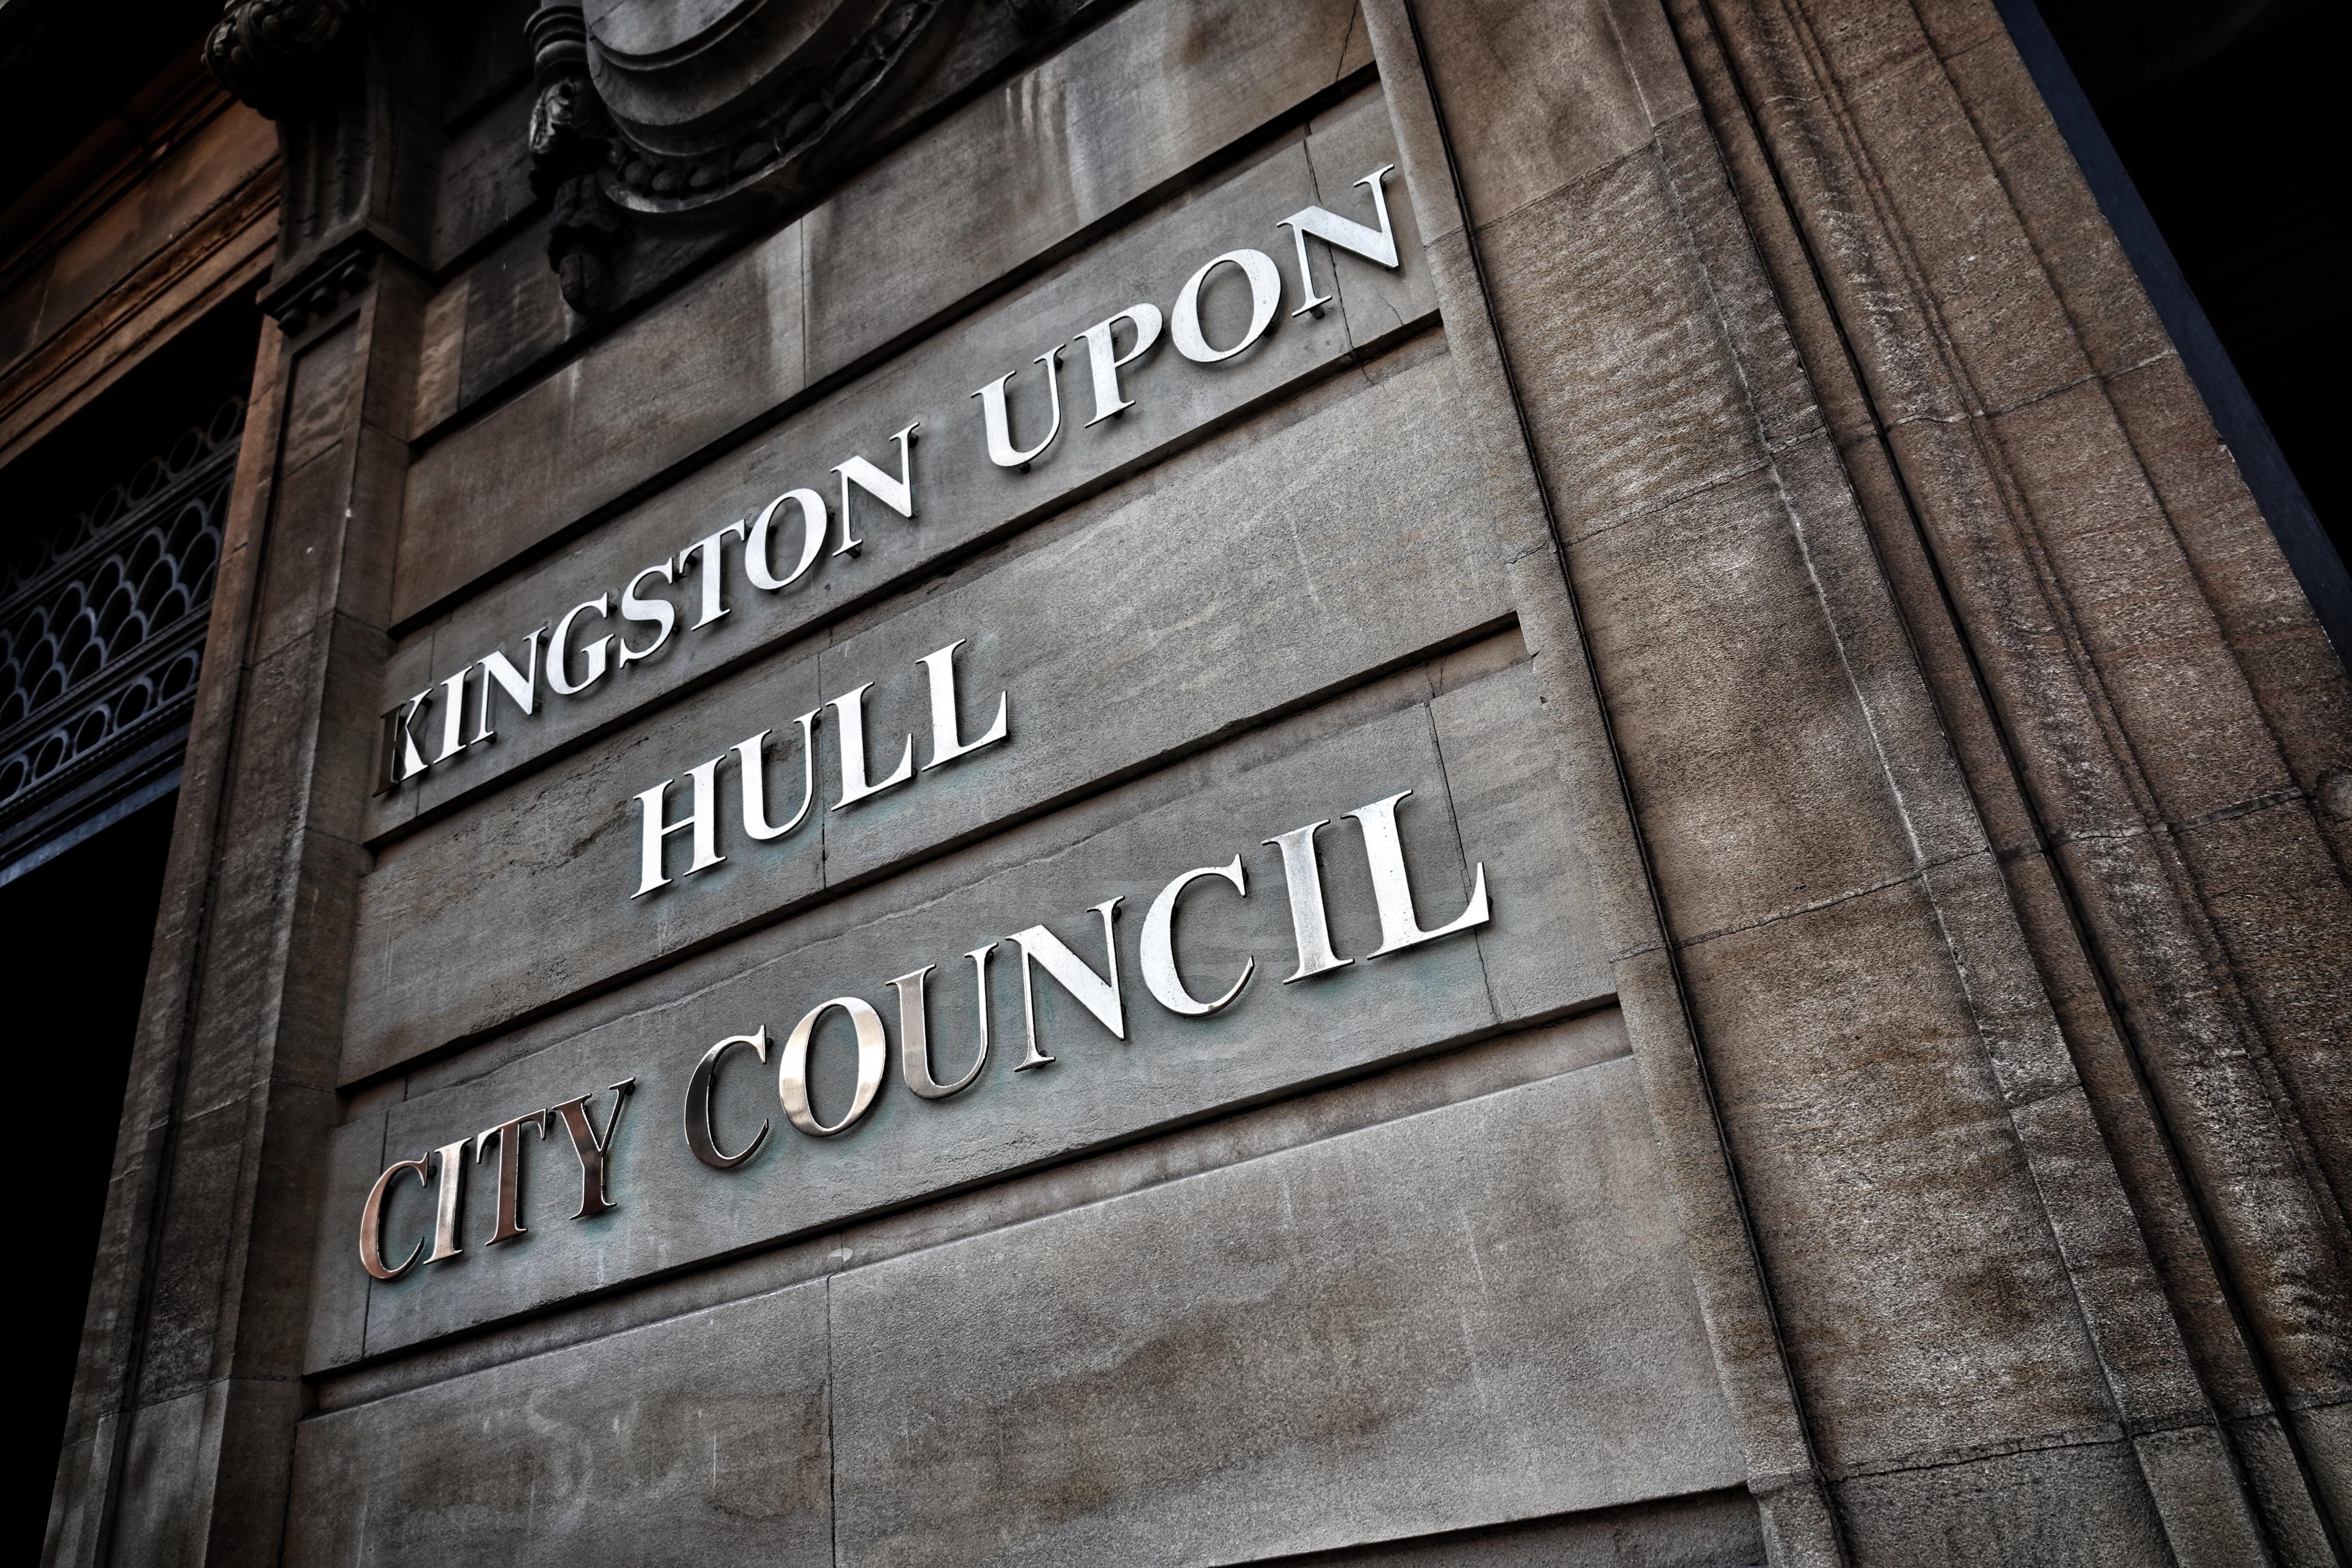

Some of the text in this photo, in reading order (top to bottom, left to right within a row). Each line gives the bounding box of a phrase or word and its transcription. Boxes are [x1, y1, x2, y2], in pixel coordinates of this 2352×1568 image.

[372, 164, 1400, 797] KINGSTON UPON
[631, 639, 1008, 899] HULL
[359, 789, 1491, 1280] CITY COUNCIL
